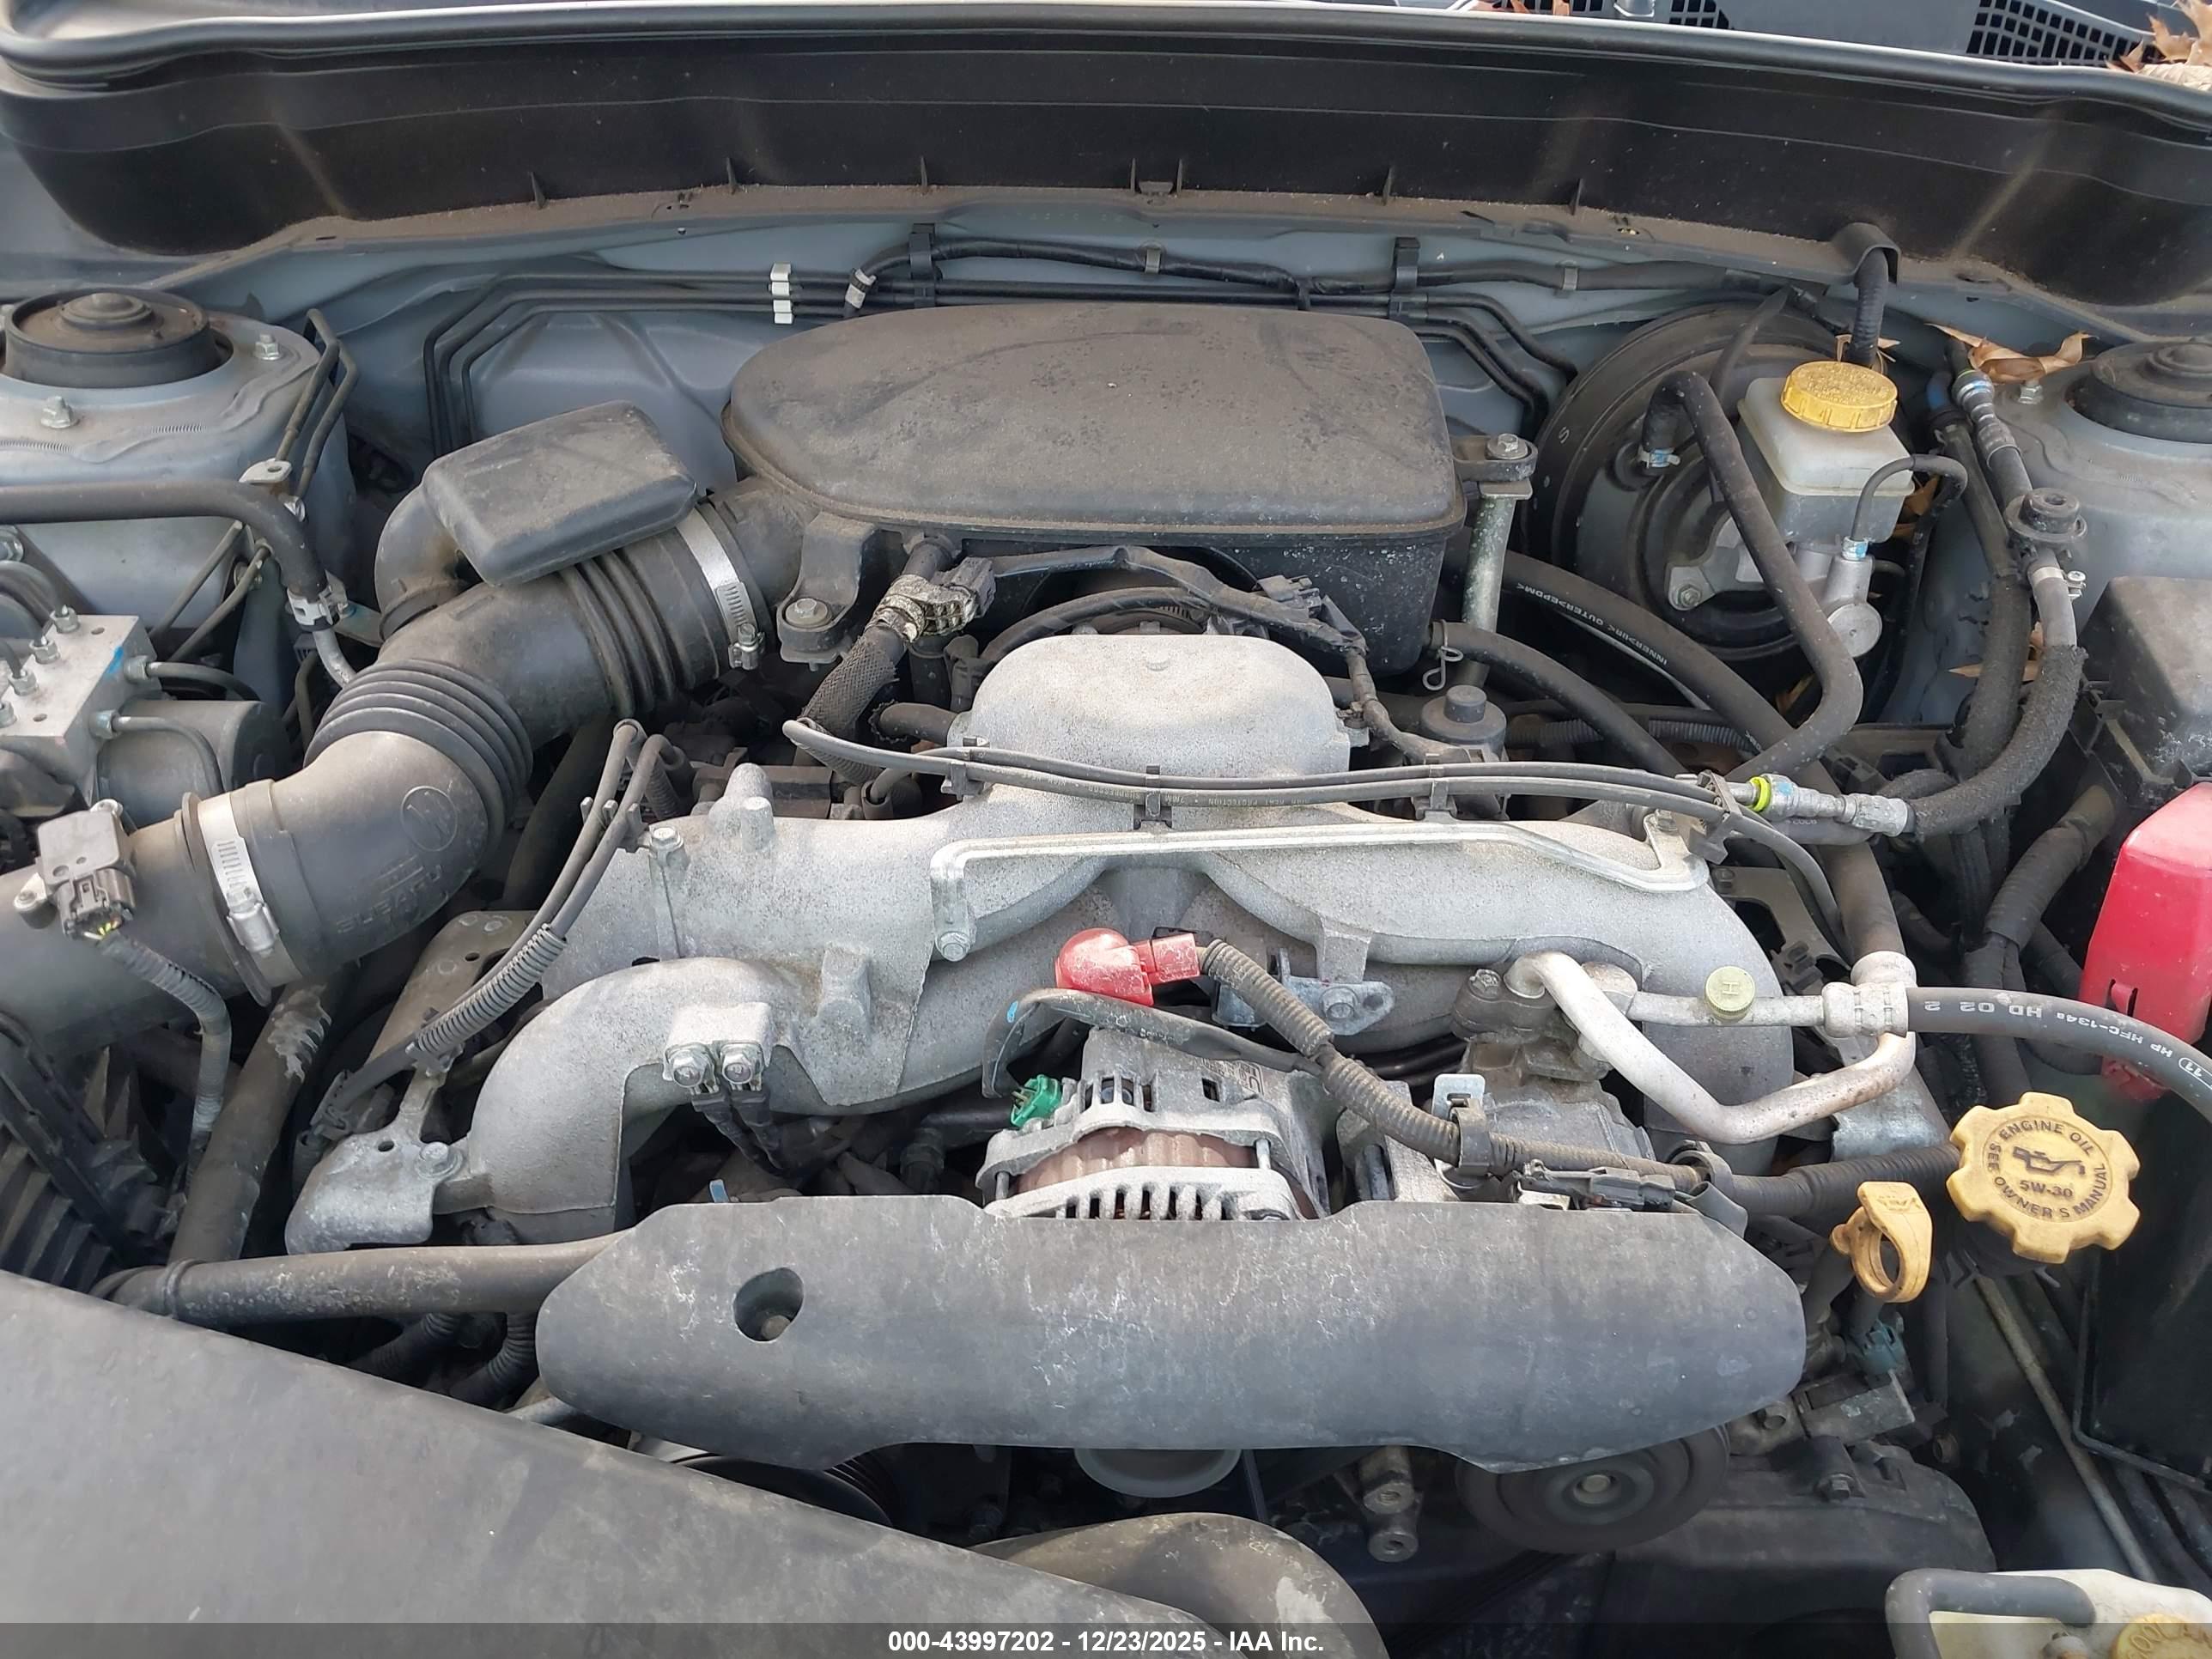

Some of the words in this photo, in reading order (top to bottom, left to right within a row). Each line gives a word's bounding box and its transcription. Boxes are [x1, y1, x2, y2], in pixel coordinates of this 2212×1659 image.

[1208, 798, 1258, 806] PROTECTION
[1924, 1000, 1941, 1012] 2
[2008, 1005, 2042, 1018] HD
[2057, 1012, 2144, 1044] HFC-134a
[2150, 1043, 2173, 1058] HP
[1999, 1120, 2064, 1141] ENGINE
[2069, 1132, 2094, 1157] OIL
[1988, 1143, 2002, 1174] SEE
[2073, 1164, 2108, 1214] MANUAL
[2020, 1180, 2073, 1198] 5W-30
